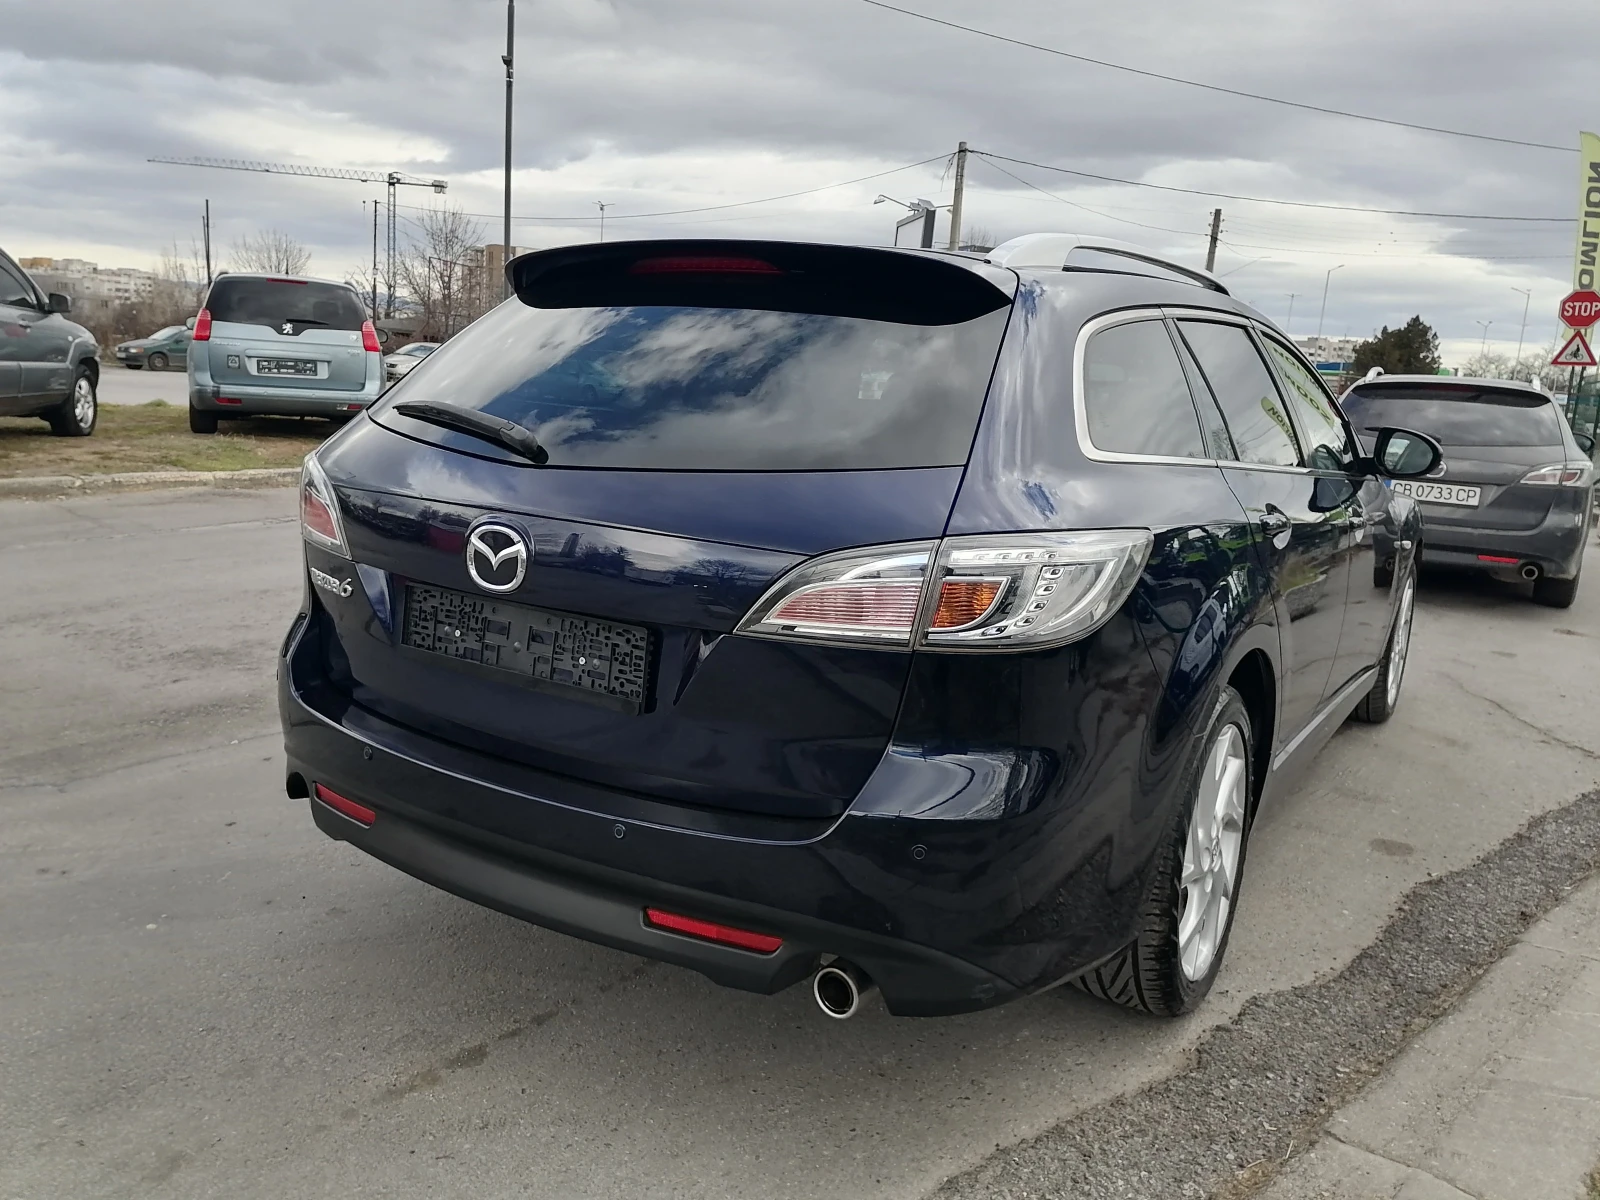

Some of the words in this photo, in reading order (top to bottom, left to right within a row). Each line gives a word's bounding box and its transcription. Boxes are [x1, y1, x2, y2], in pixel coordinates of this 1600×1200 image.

[1563, 301, 1600, 317] STOP
[1393, 482, 1413, 497] CB
[1416, 484, 1453, 500] 0733
[1456, 488, 1477, 502] CP
